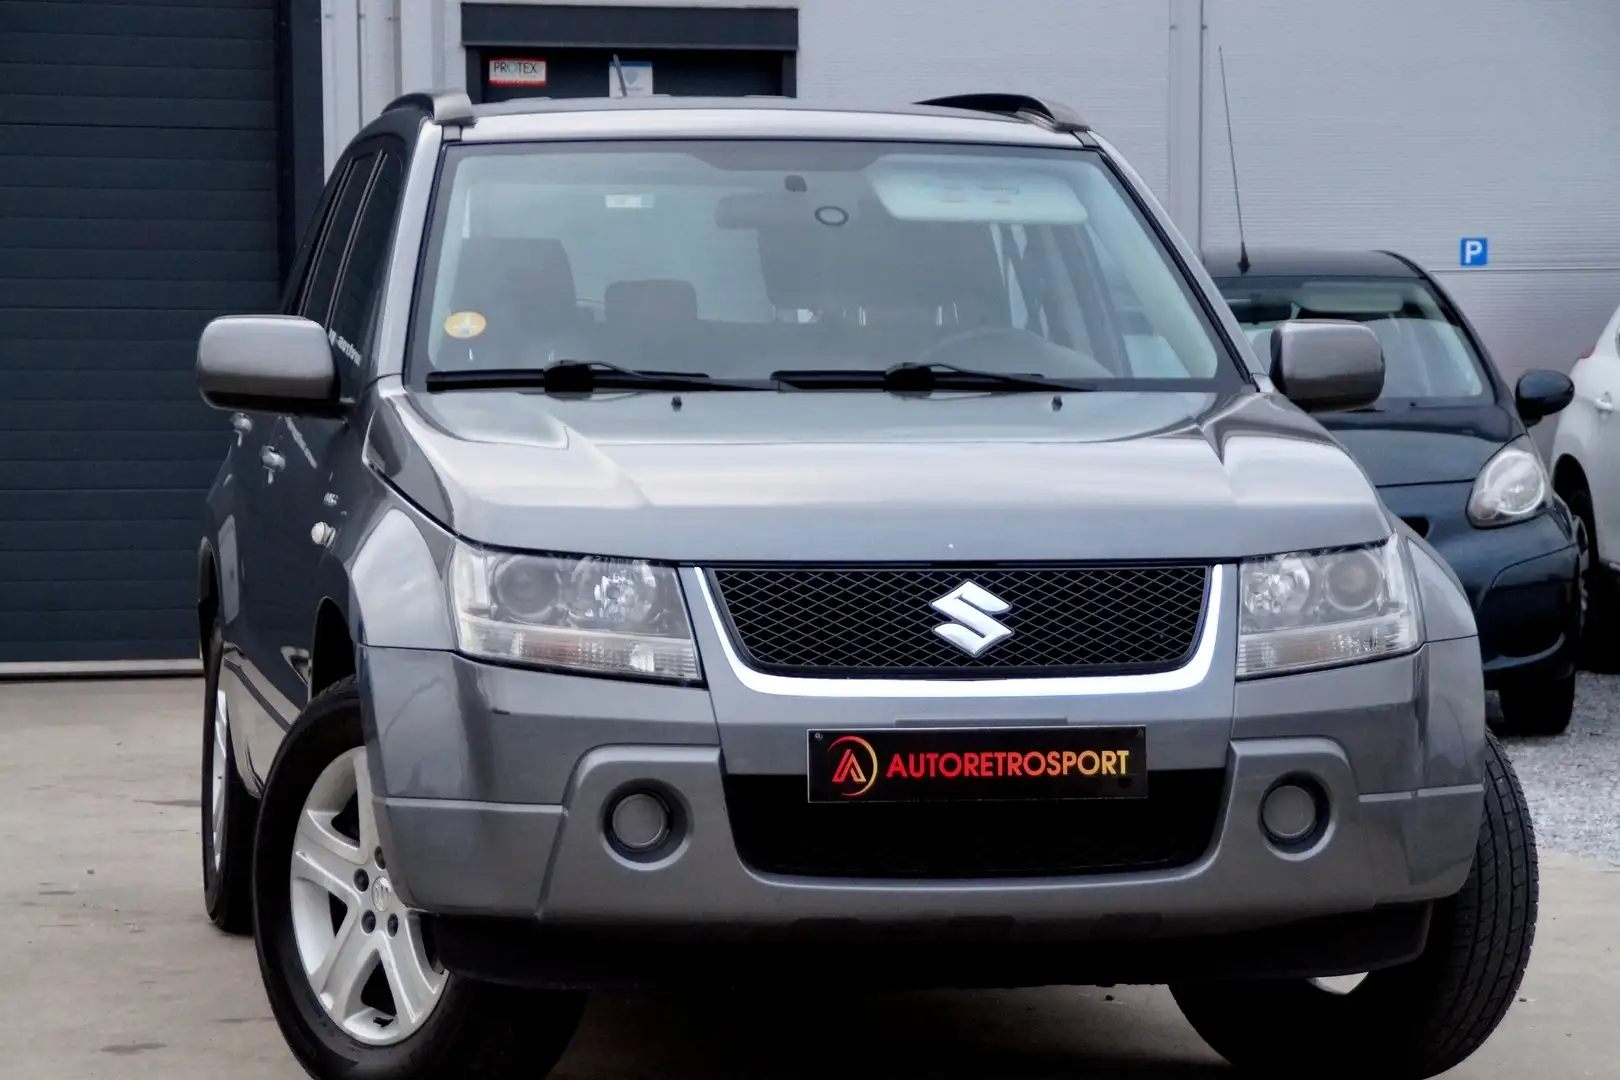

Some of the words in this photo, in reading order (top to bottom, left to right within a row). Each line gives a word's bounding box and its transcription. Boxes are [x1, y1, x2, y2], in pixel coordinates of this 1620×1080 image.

[493, 61, 538, 76] PROTEX
[1465, 240, 1483, 264] P
[886, 750, 1130, 778] AUTORETROSPORT
